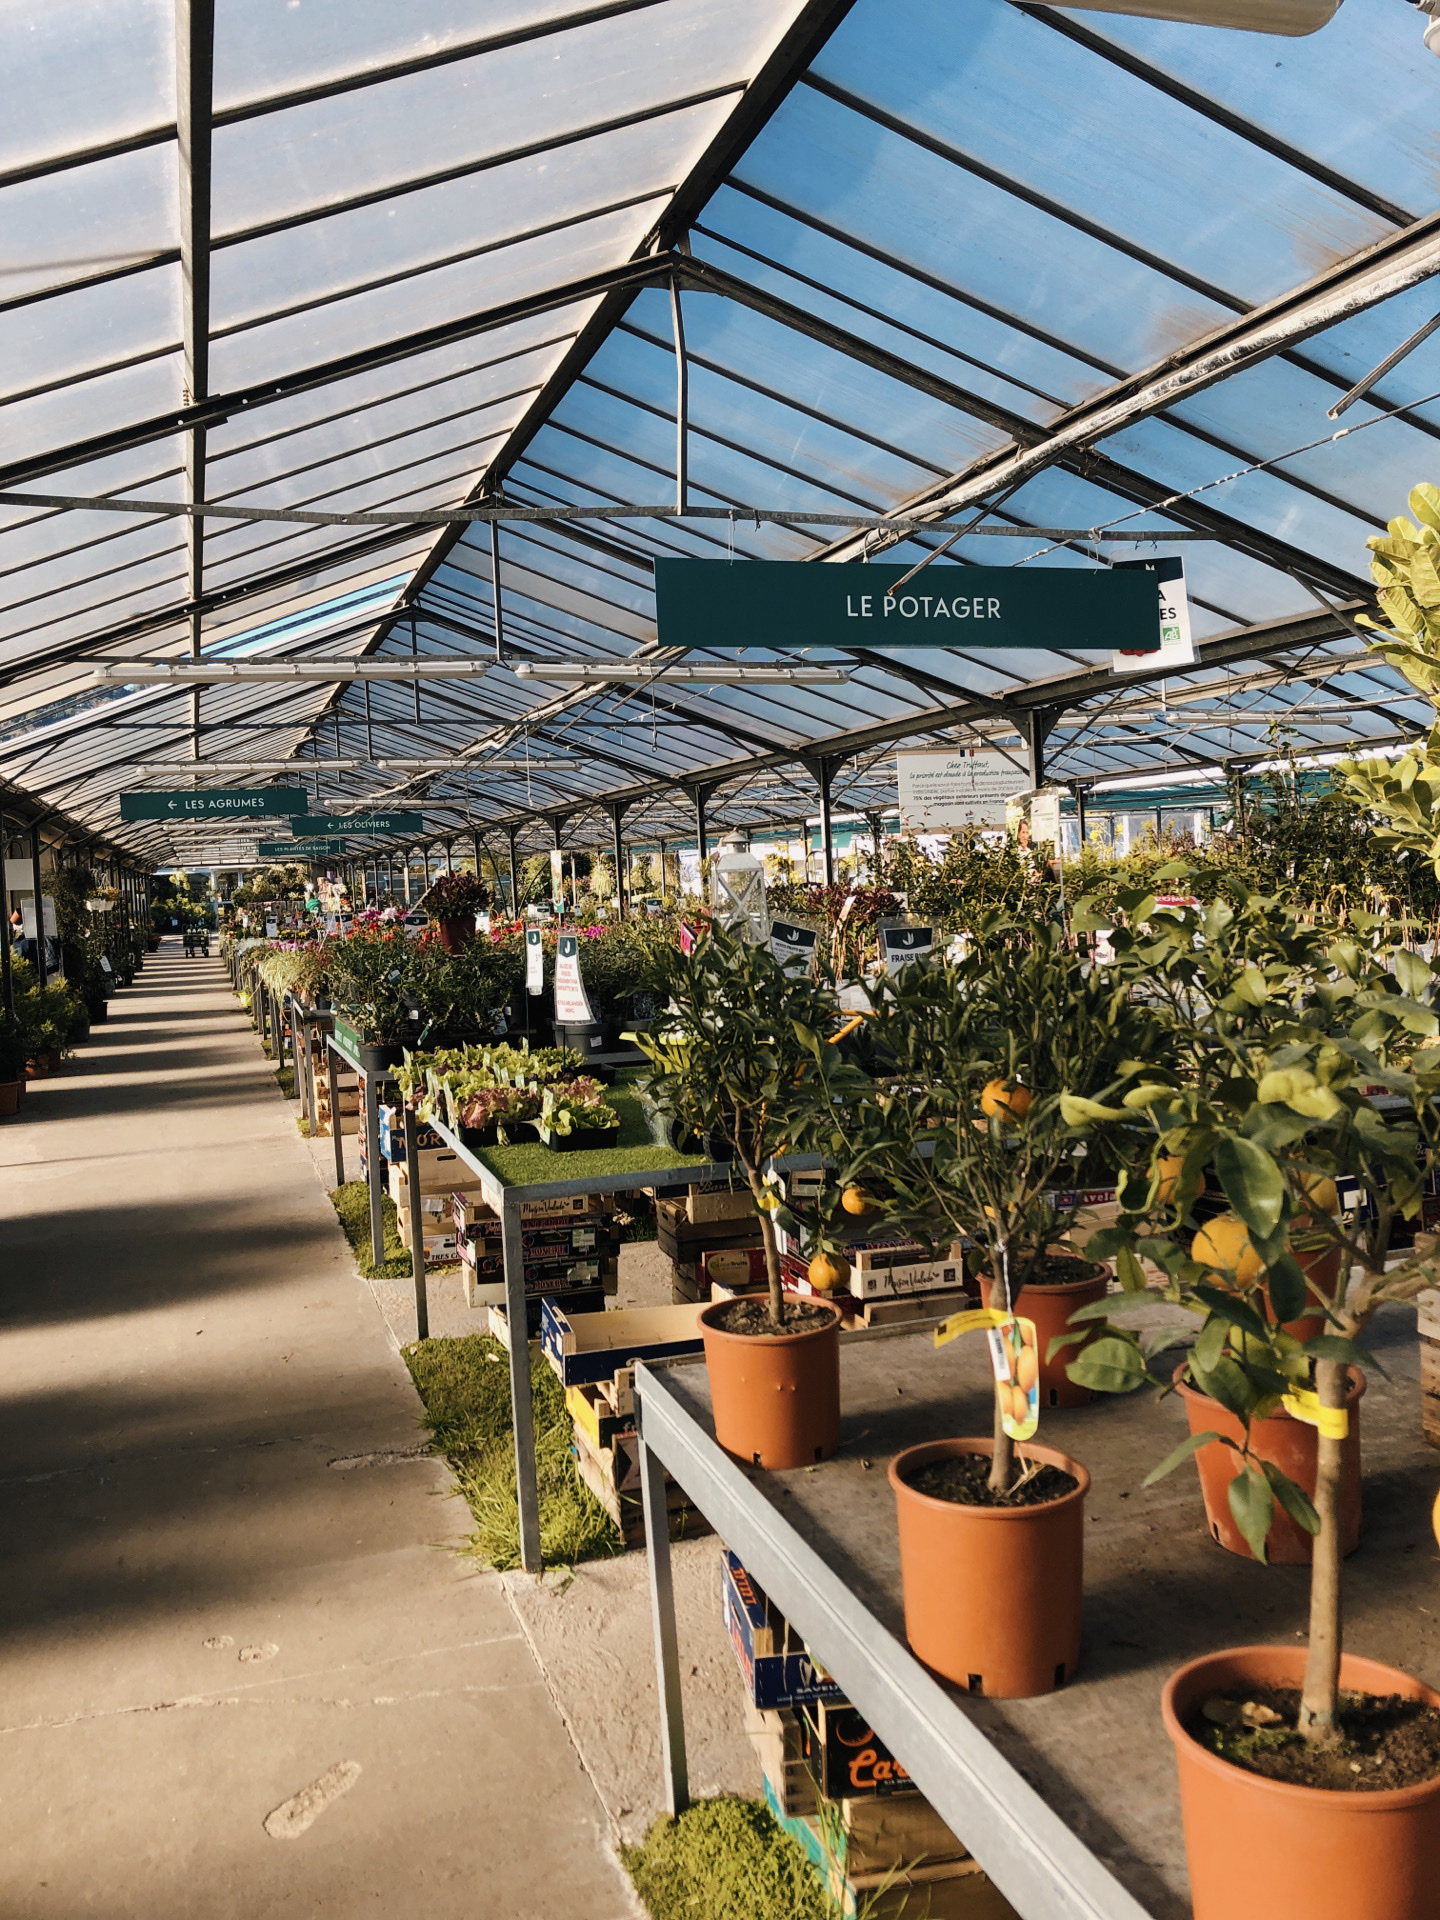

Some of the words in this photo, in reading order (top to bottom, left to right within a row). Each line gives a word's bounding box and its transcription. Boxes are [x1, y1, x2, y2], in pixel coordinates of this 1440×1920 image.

[847, 595, 873, 618] LE
[884, 595, 1001, 619] POTAGER
[947, 761, 961, 769] Chez
[185, 800, 205, 810] LES
[208, 797, 265, 809] AGRUMES
[338, 821, 353, 830] LES
[354, 820, 391, 829] OLIVIERS
[891, 953, 915, 963] FRAISE
